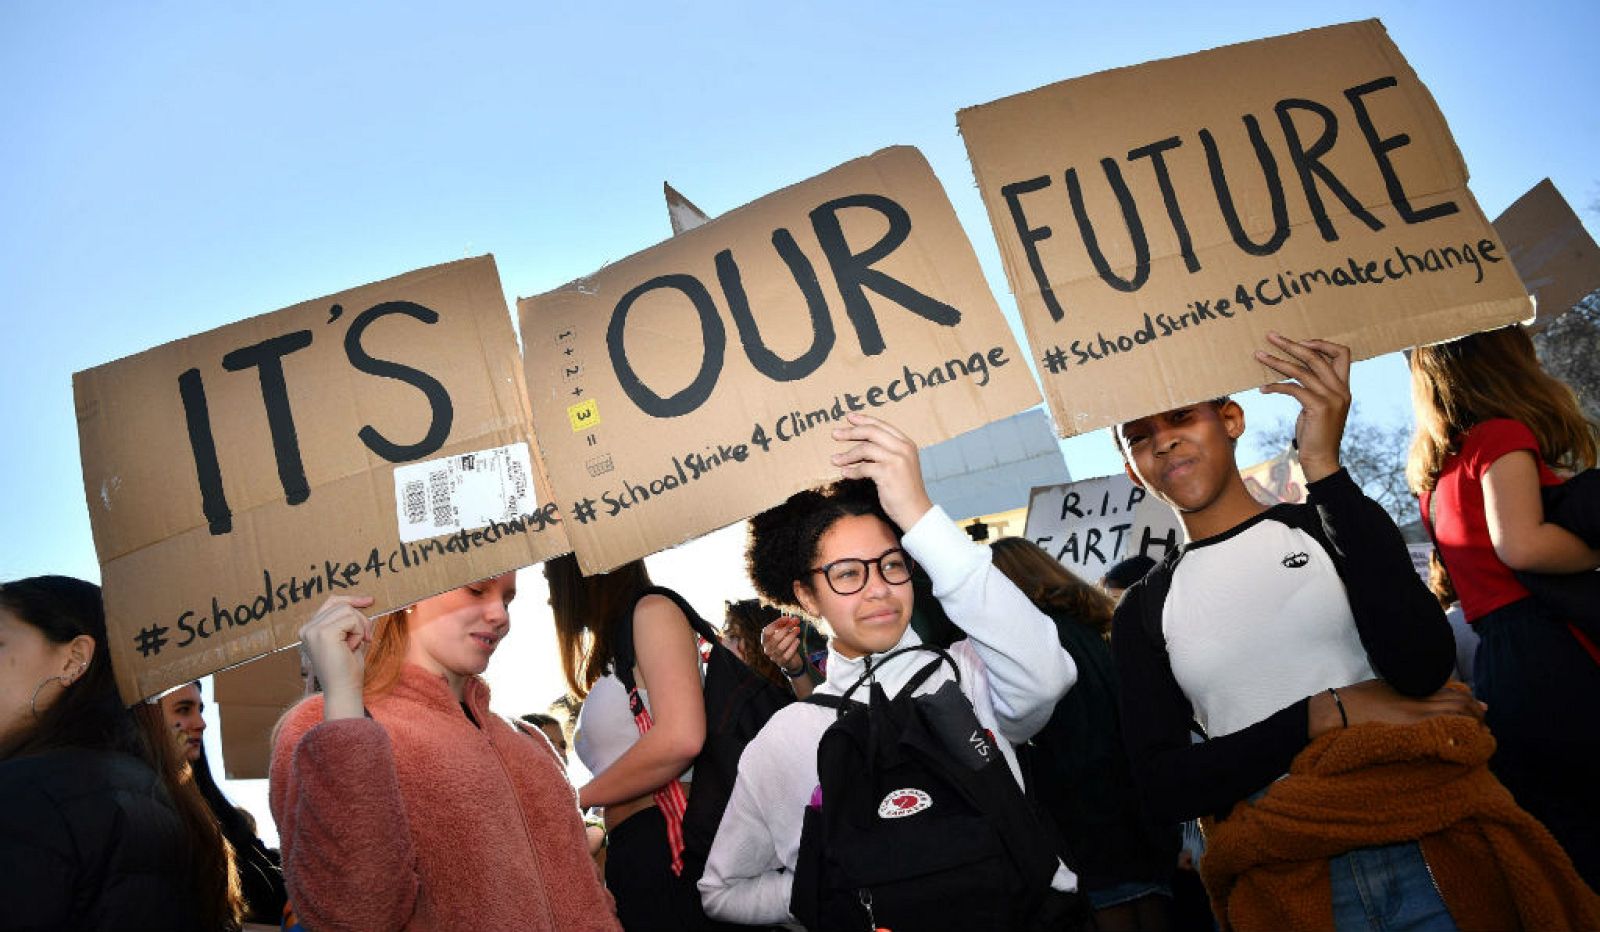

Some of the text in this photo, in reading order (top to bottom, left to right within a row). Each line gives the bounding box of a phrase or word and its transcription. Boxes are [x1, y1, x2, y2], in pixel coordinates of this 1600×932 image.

[606, 193, 962, 418] OUR
[1002, 76, 1459, 323] FUTURE
[178, 300, 454, 535] IT'S
[576, 409, 592, 421] 3
